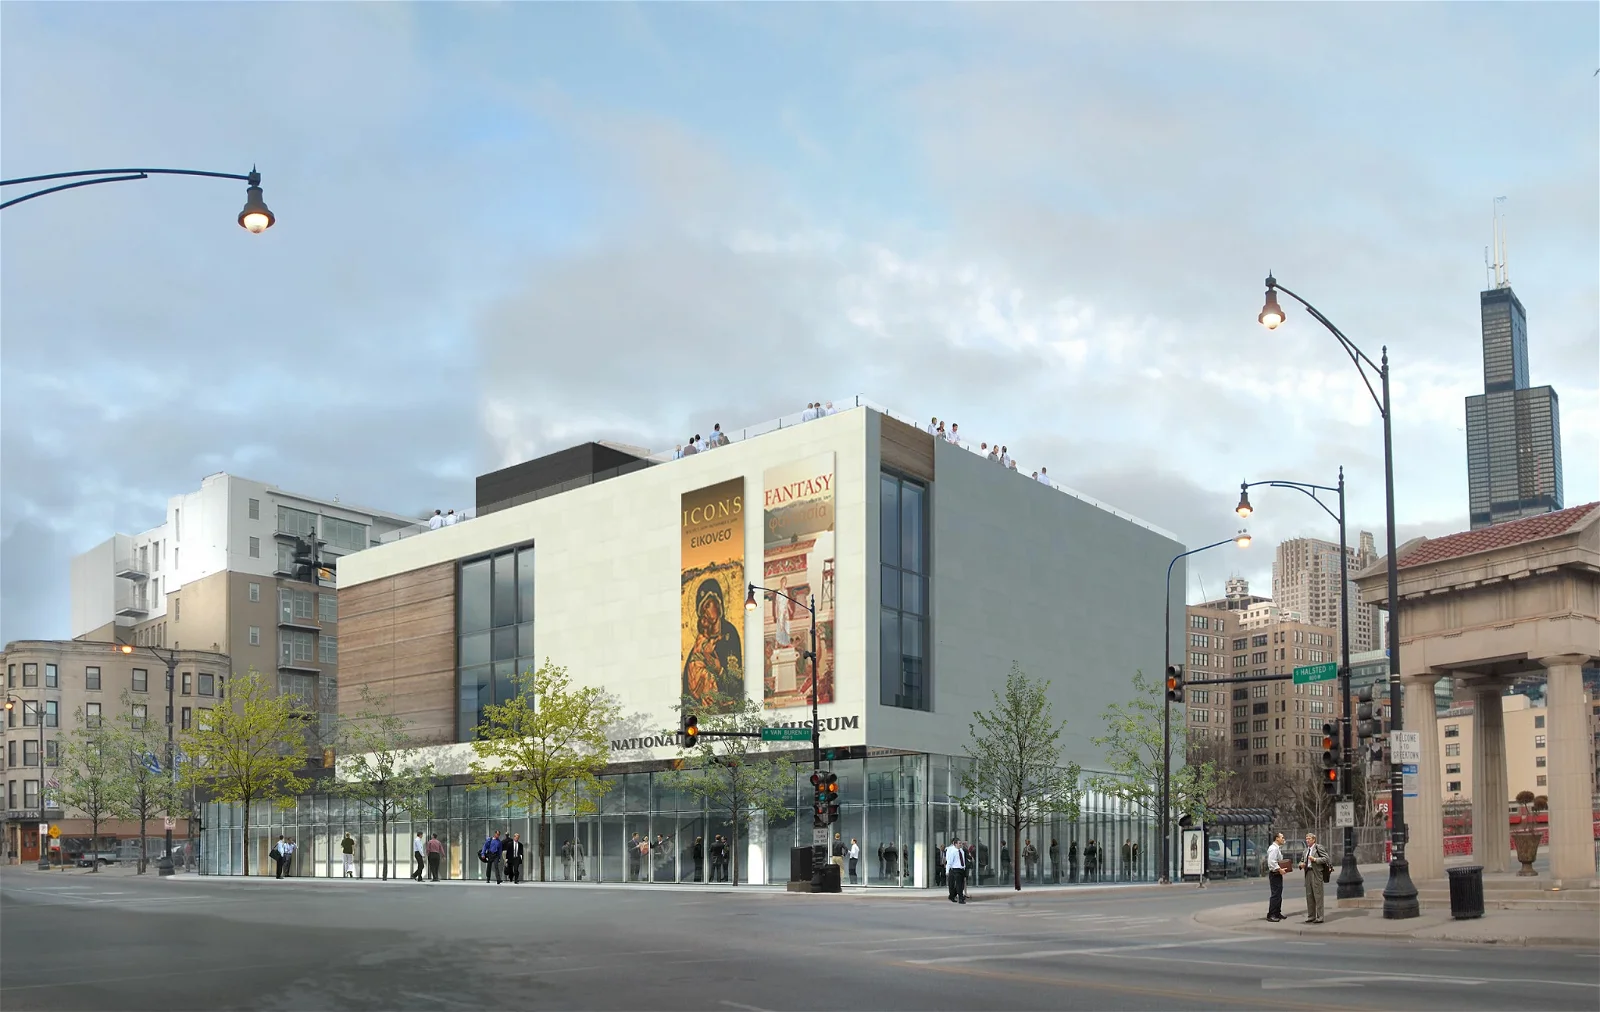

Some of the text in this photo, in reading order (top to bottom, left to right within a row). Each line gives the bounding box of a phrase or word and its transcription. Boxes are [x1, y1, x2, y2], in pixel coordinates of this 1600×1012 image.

[764, 473, 833, 507] FANTASY
[683, 496, 742, 527] ICONS
[1300, 665, 1327, 676] HALSTED
[611, 733, 682, 752] NATIONAL
[1395, 734, 1416, 742] WELCOME
